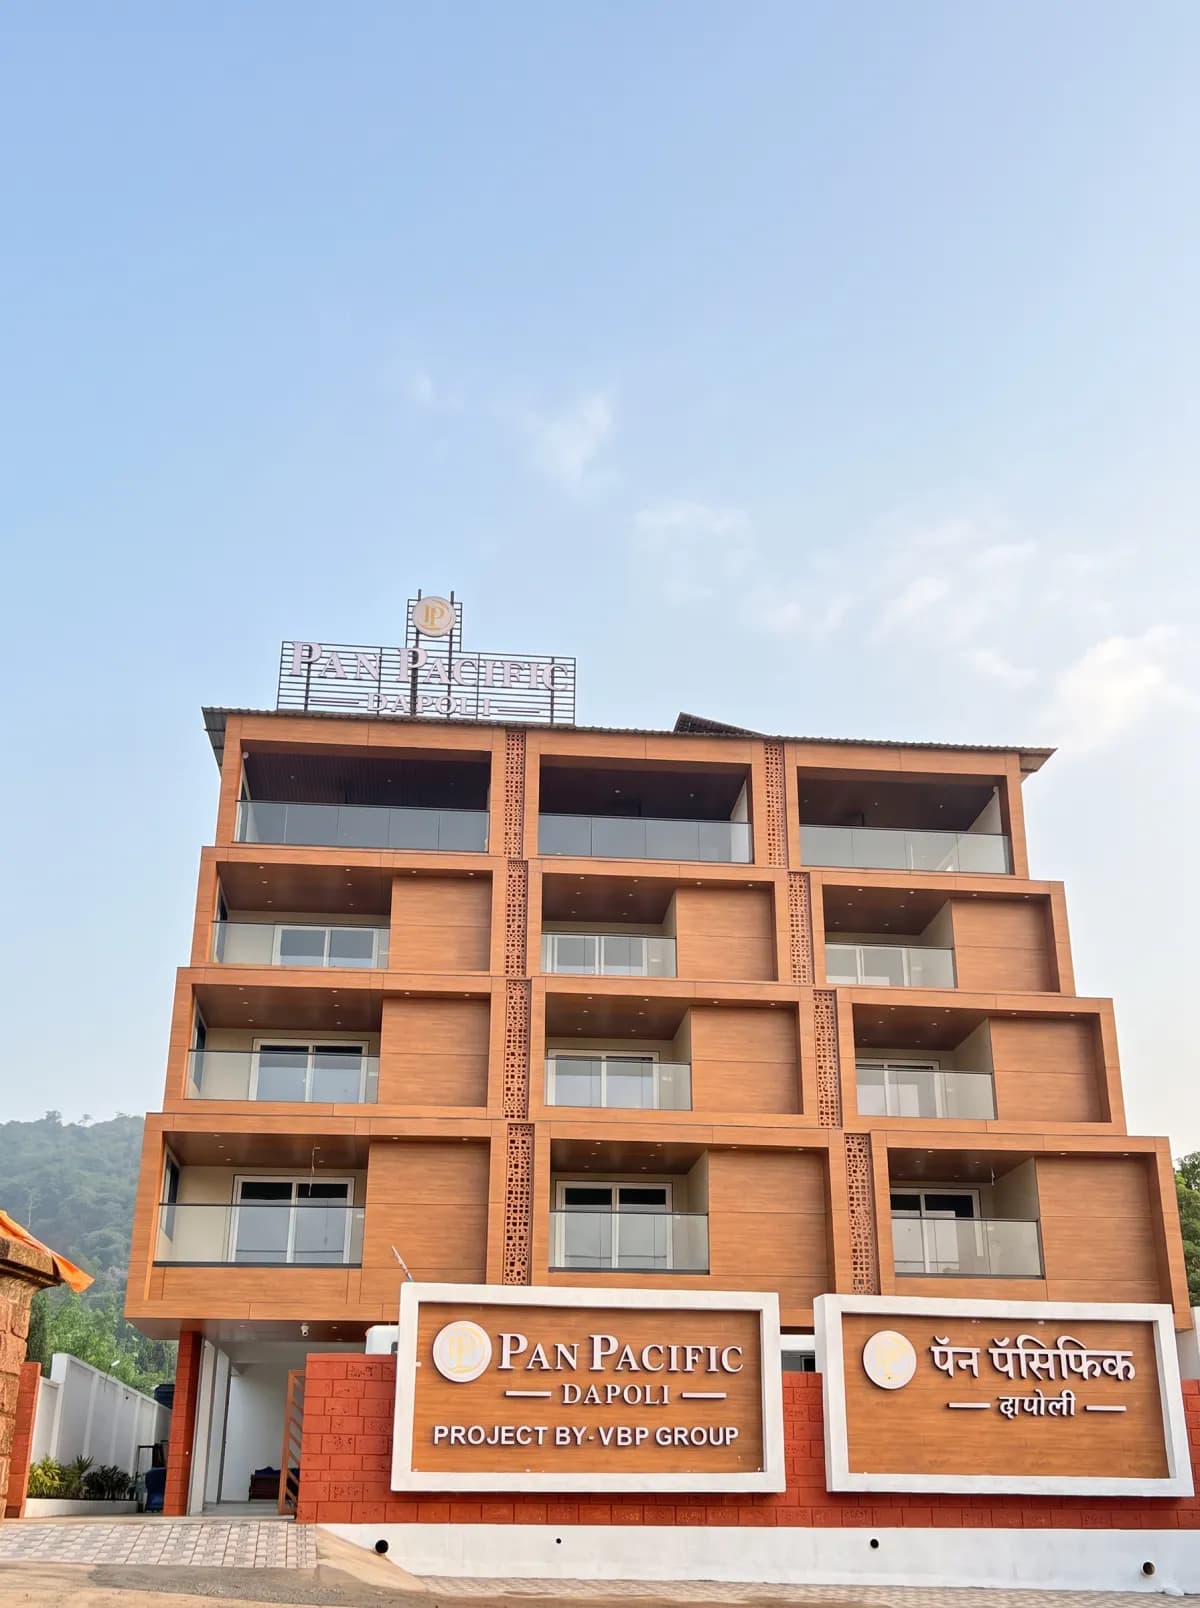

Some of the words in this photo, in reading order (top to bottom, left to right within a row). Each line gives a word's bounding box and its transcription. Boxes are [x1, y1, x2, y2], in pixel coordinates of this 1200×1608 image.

[289, 640, 382, 681] PAN
[396, 647, 569, 691] PACIFIC
[366, 692, 492, 717] DAPOLI
[497, 1333, 580, 1371] PAN
[588, 1334, 744, 1374] PACIFIC
[561, 1383, 672, 1406] DAPOLI
[998, 1389, 1077, 1419] दापोली
[433, 1425, 548, 1446] PROJECT
[655, 1426, 739, 1446] GROUP
